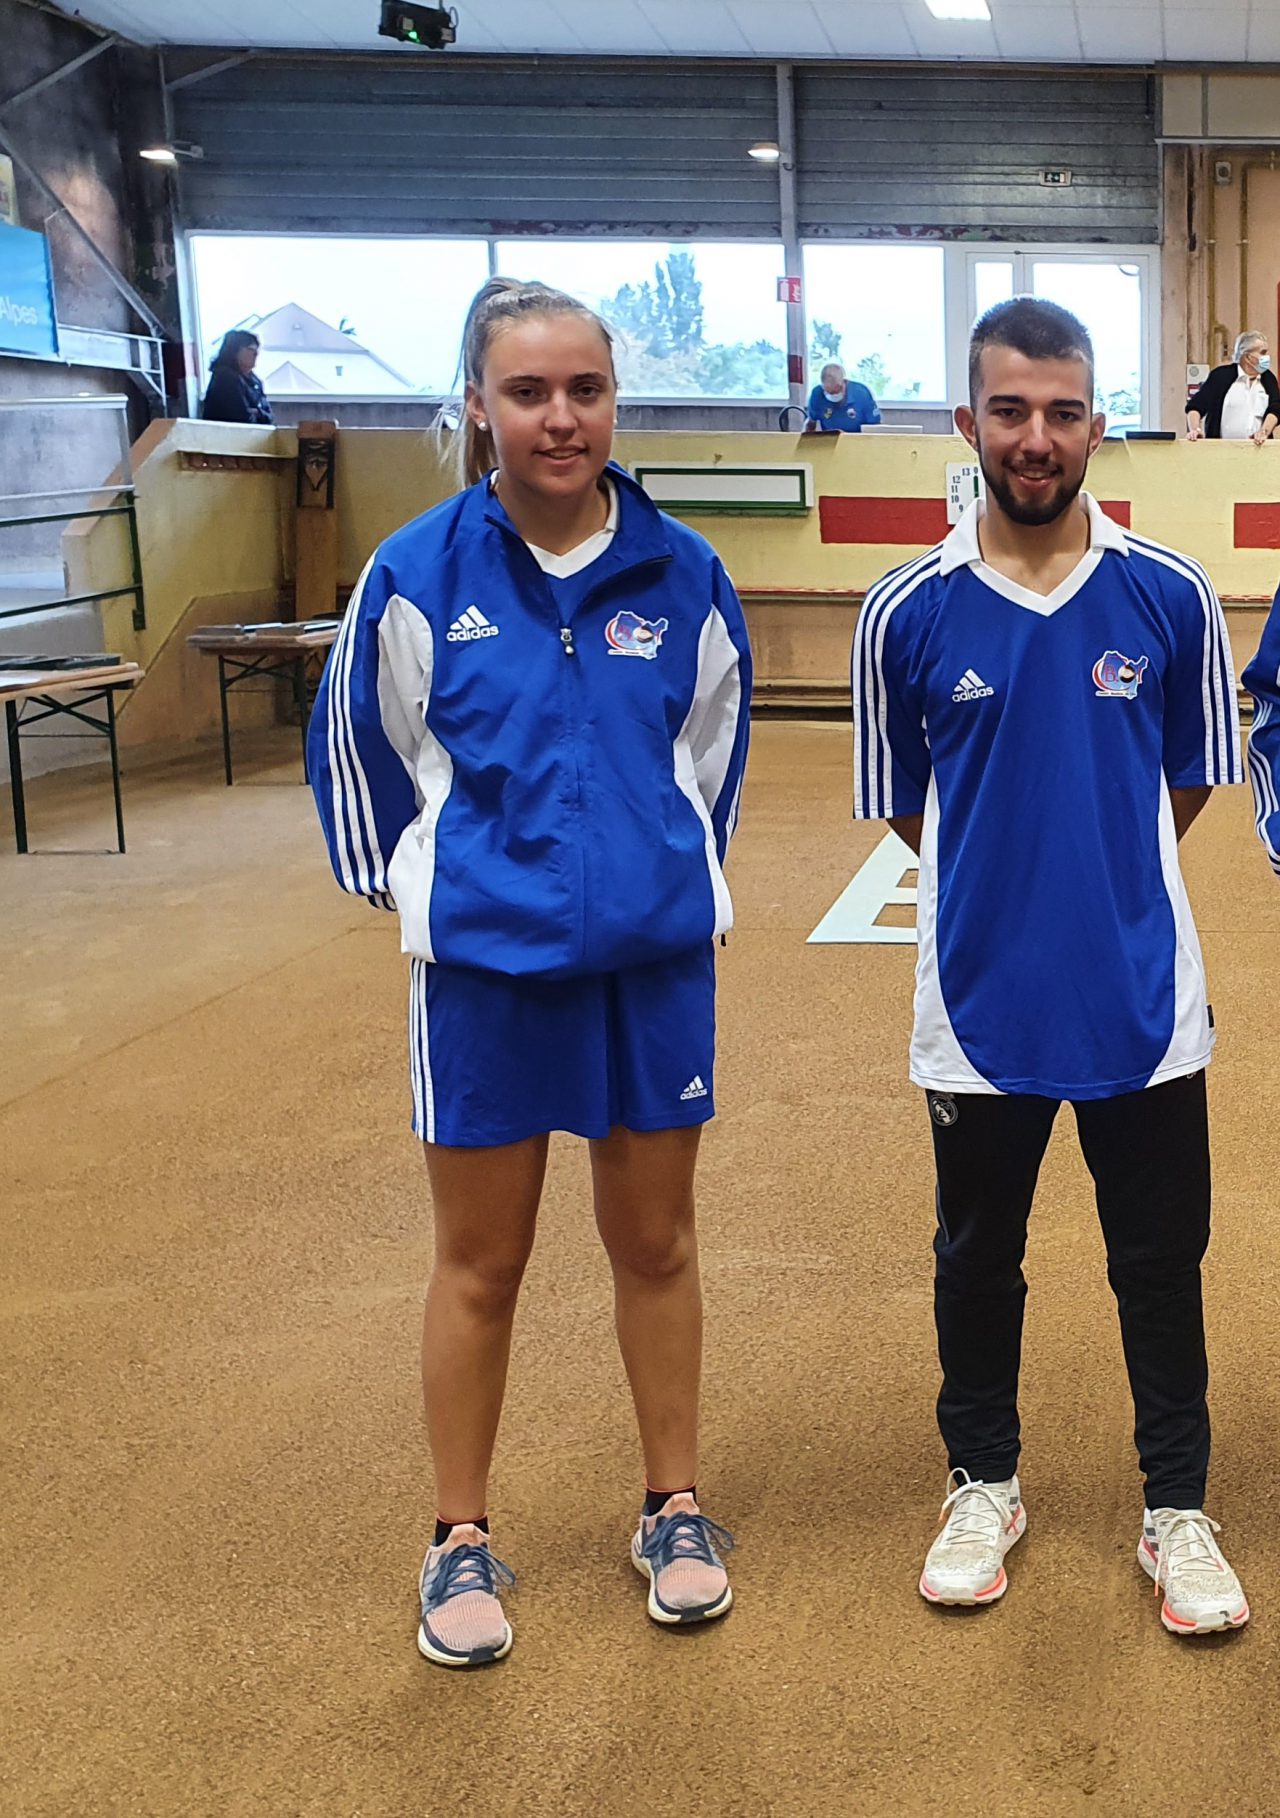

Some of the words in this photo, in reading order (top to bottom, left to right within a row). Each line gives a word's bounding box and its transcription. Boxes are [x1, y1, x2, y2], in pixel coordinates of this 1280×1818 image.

[962, 467, 970, 476] 13
[952, 475, 960, 484] 12
[951, 485, 958, 493] 11
[951, 495, 959, 503] 10
[446, 625, 499, 642] adidas
[952, 686, 994, 702] adidas
[680, 1088, 708, 1100] adidas
